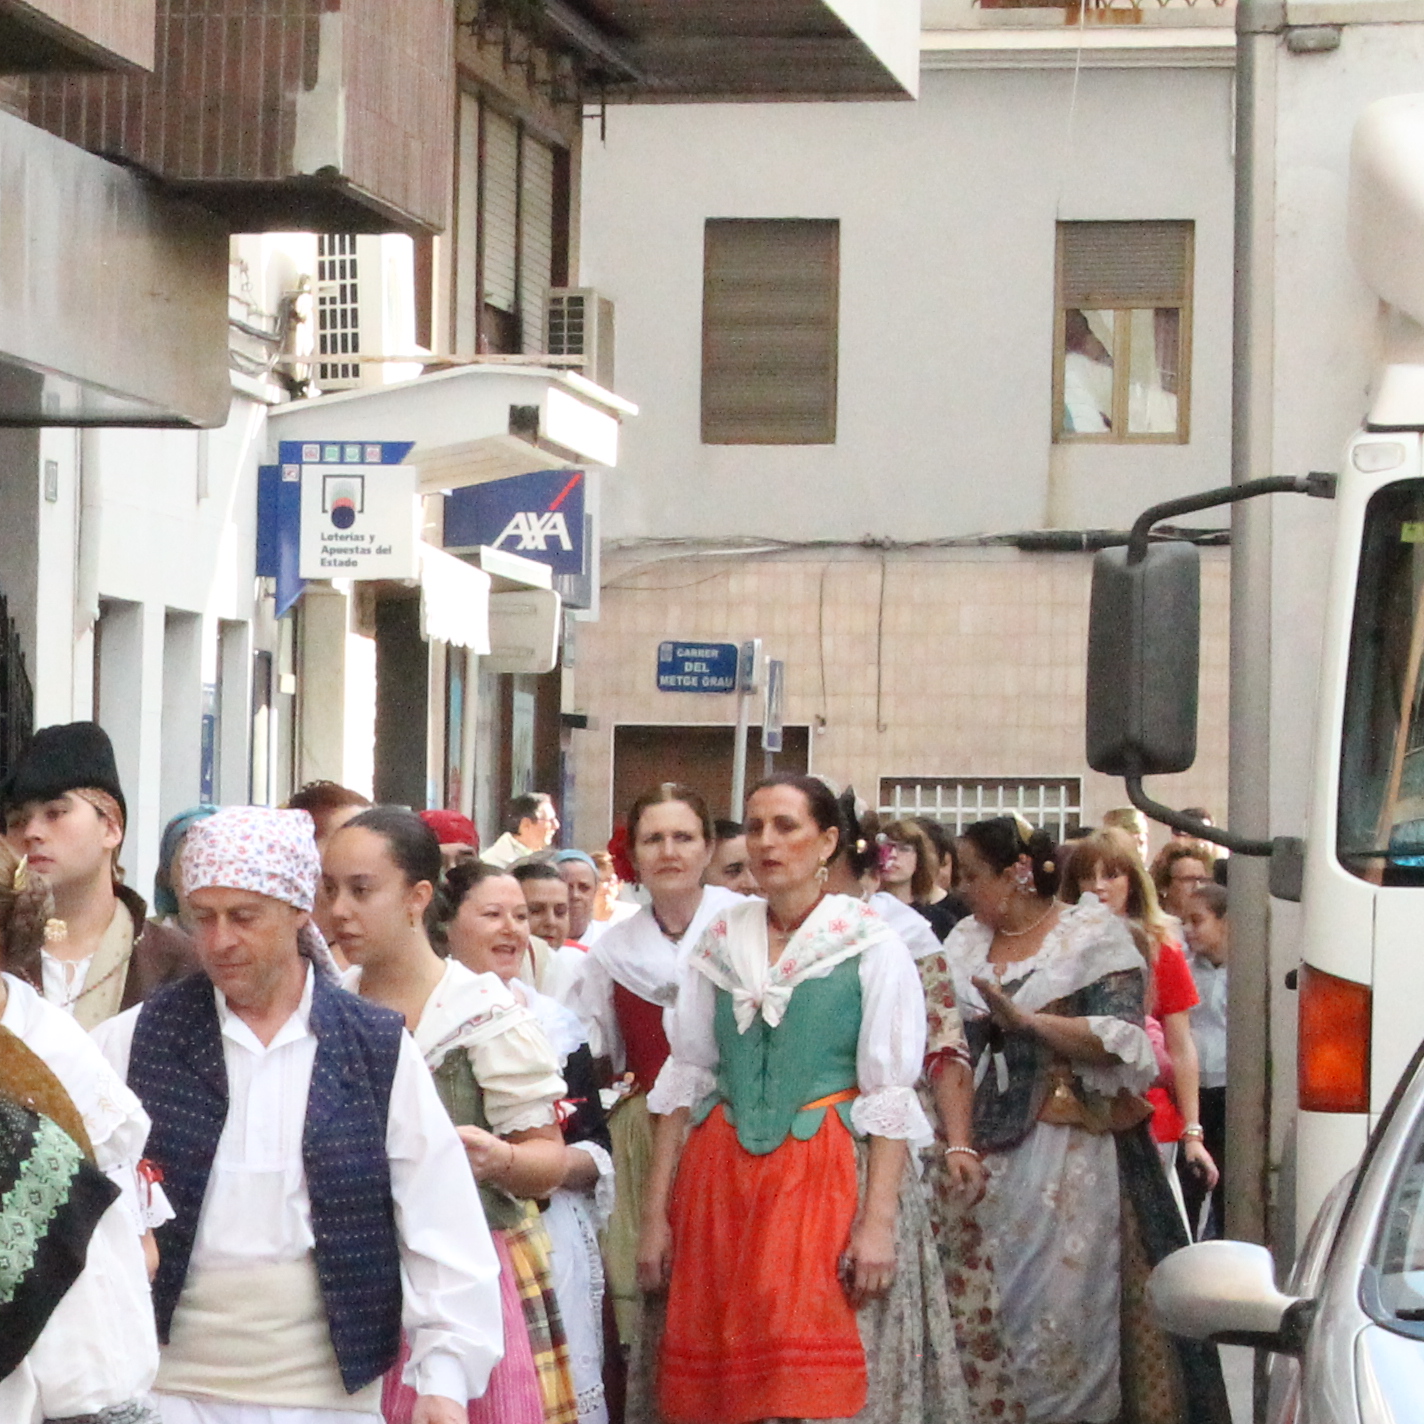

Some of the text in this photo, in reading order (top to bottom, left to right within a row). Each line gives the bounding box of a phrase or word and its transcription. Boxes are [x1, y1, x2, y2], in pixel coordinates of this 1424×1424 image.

[492, 511, 573, 551] AXA
[369, 534, 375, 544] y
[321, 545, 392, 556] Apuestas del
[320, 558, 358, 567] Estado
[676, 648, 719, 658] CARRER
[684, 662, 710, 673] DEL
[659, 675, 733, 687] METGE GRAU
